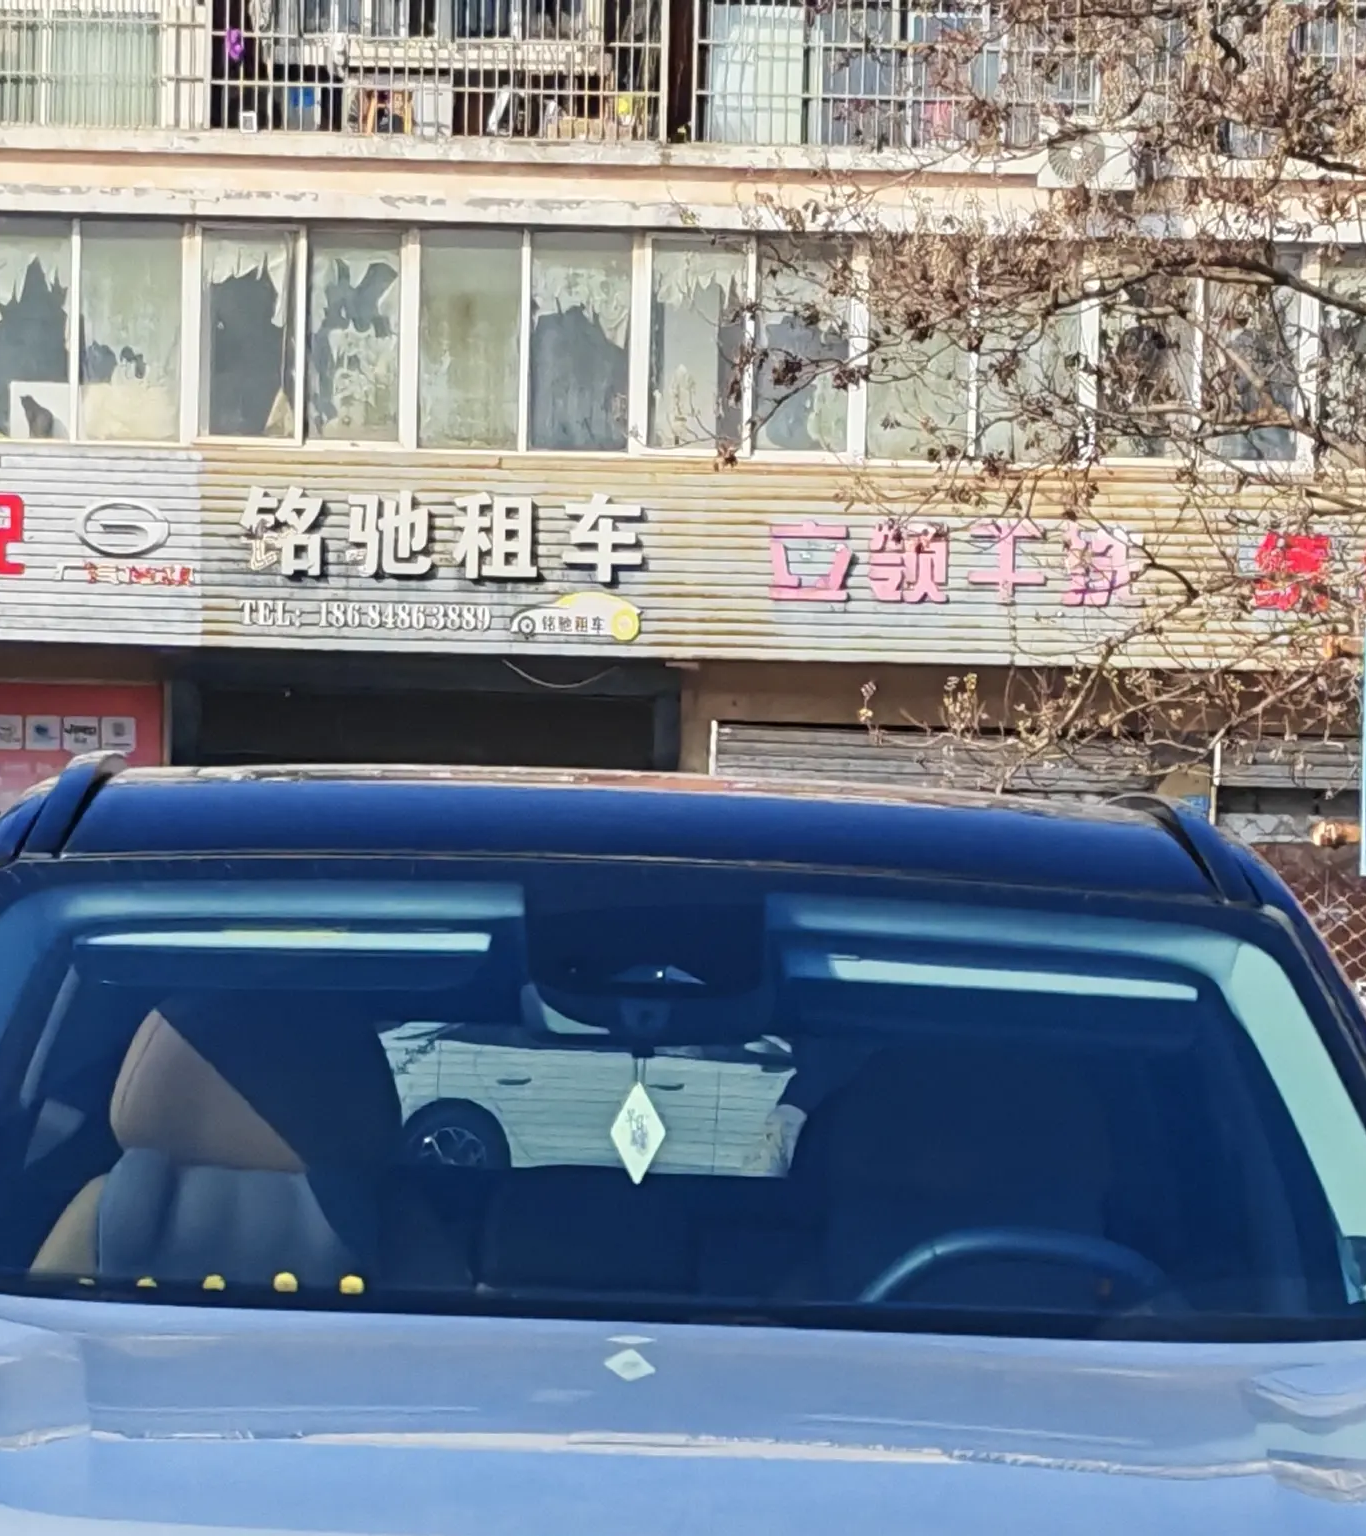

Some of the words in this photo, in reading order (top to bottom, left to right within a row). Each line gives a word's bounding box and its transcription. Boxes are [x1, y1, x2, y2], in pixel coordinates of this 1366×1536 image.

[239, 485, 644, 584] 铭驰租车
[541, 615, 606, 634] 铭驰租车
